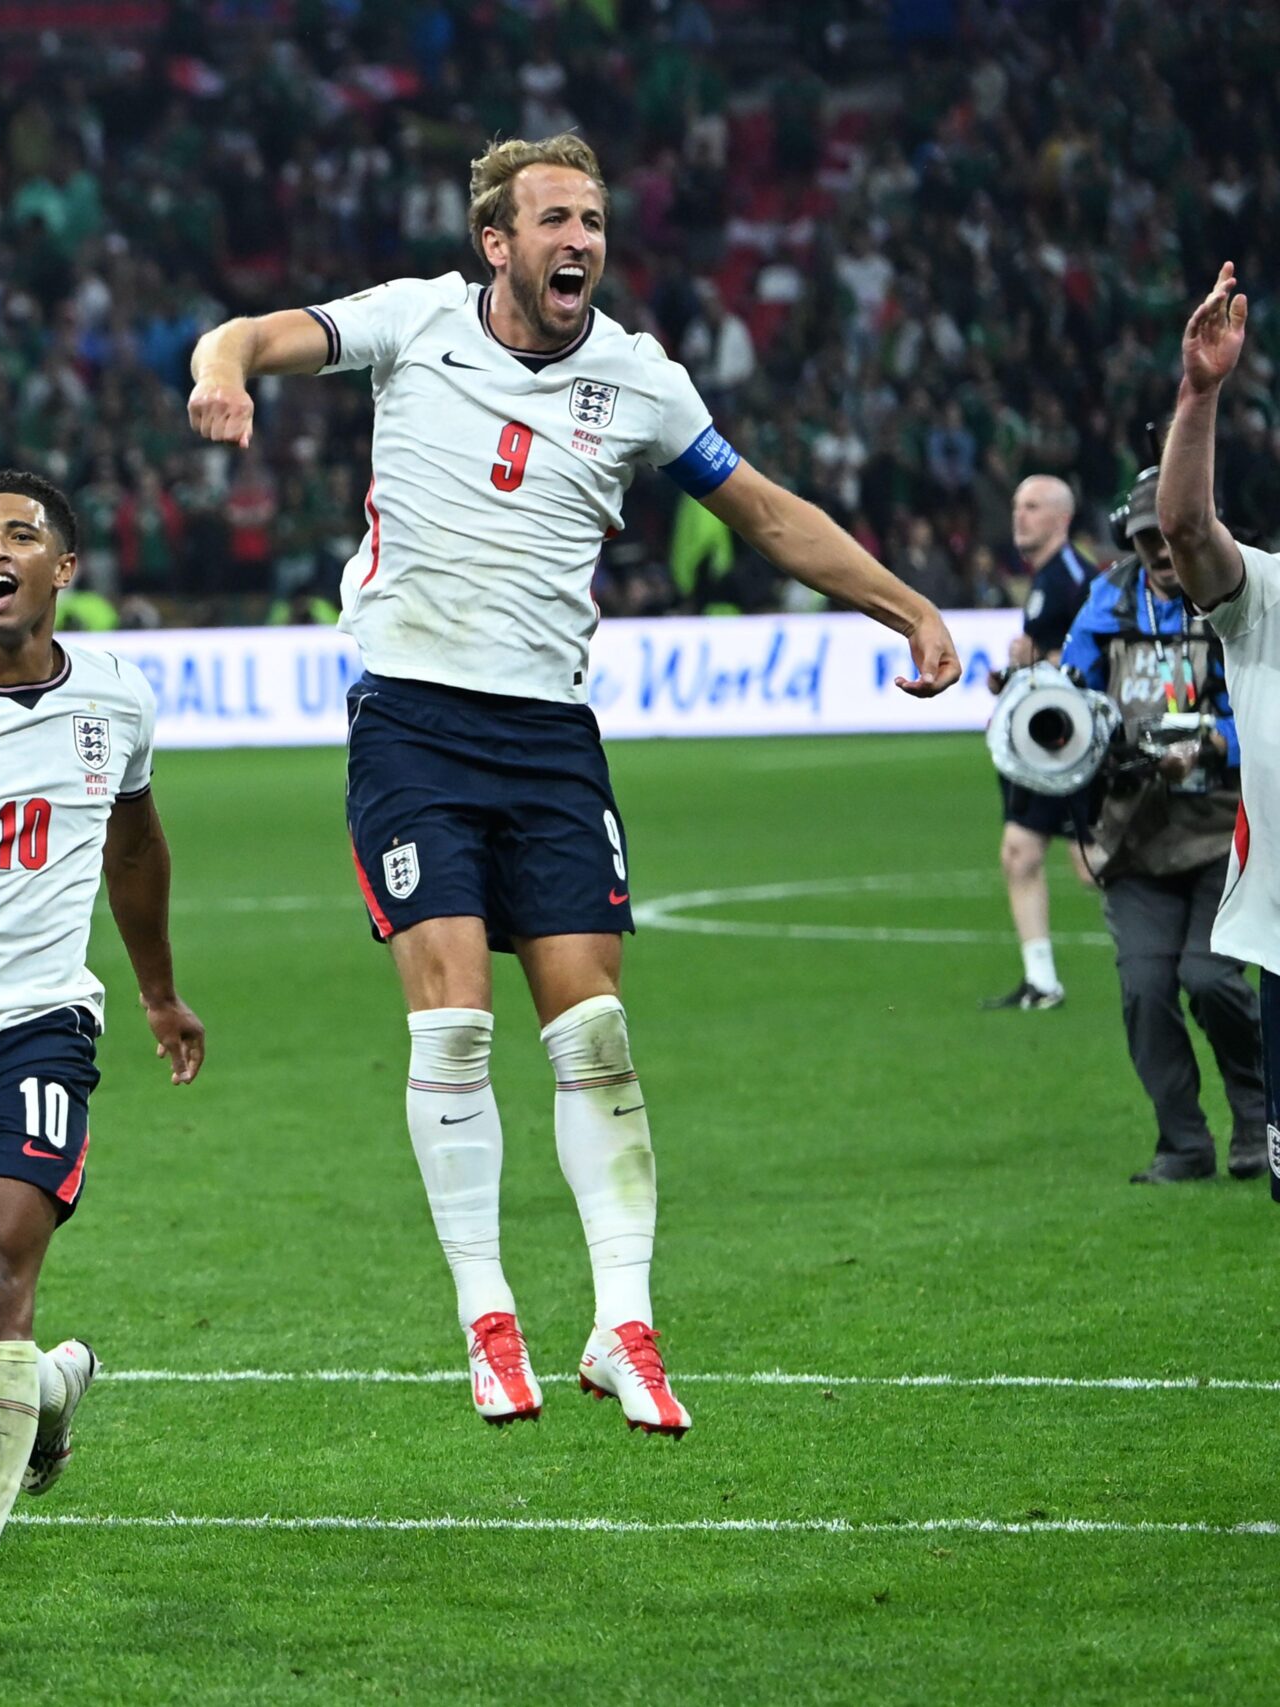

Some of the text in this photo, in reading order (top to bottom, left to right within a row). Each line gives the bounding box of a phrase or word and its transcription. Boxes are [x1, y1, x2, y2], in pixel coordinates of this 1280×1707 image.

[490, 420, 533, 493] 9
[574, 428, 602, 445] MEXICO
[137, 655, 268, 717] BALL
[639, 629, 828, 715] World
[872, 645, 995, 689] FA
[85, 774, 107, 784] MEXICO
[603, 809, 626, 881] 9
[19, 1077, 69, 1149] 10
